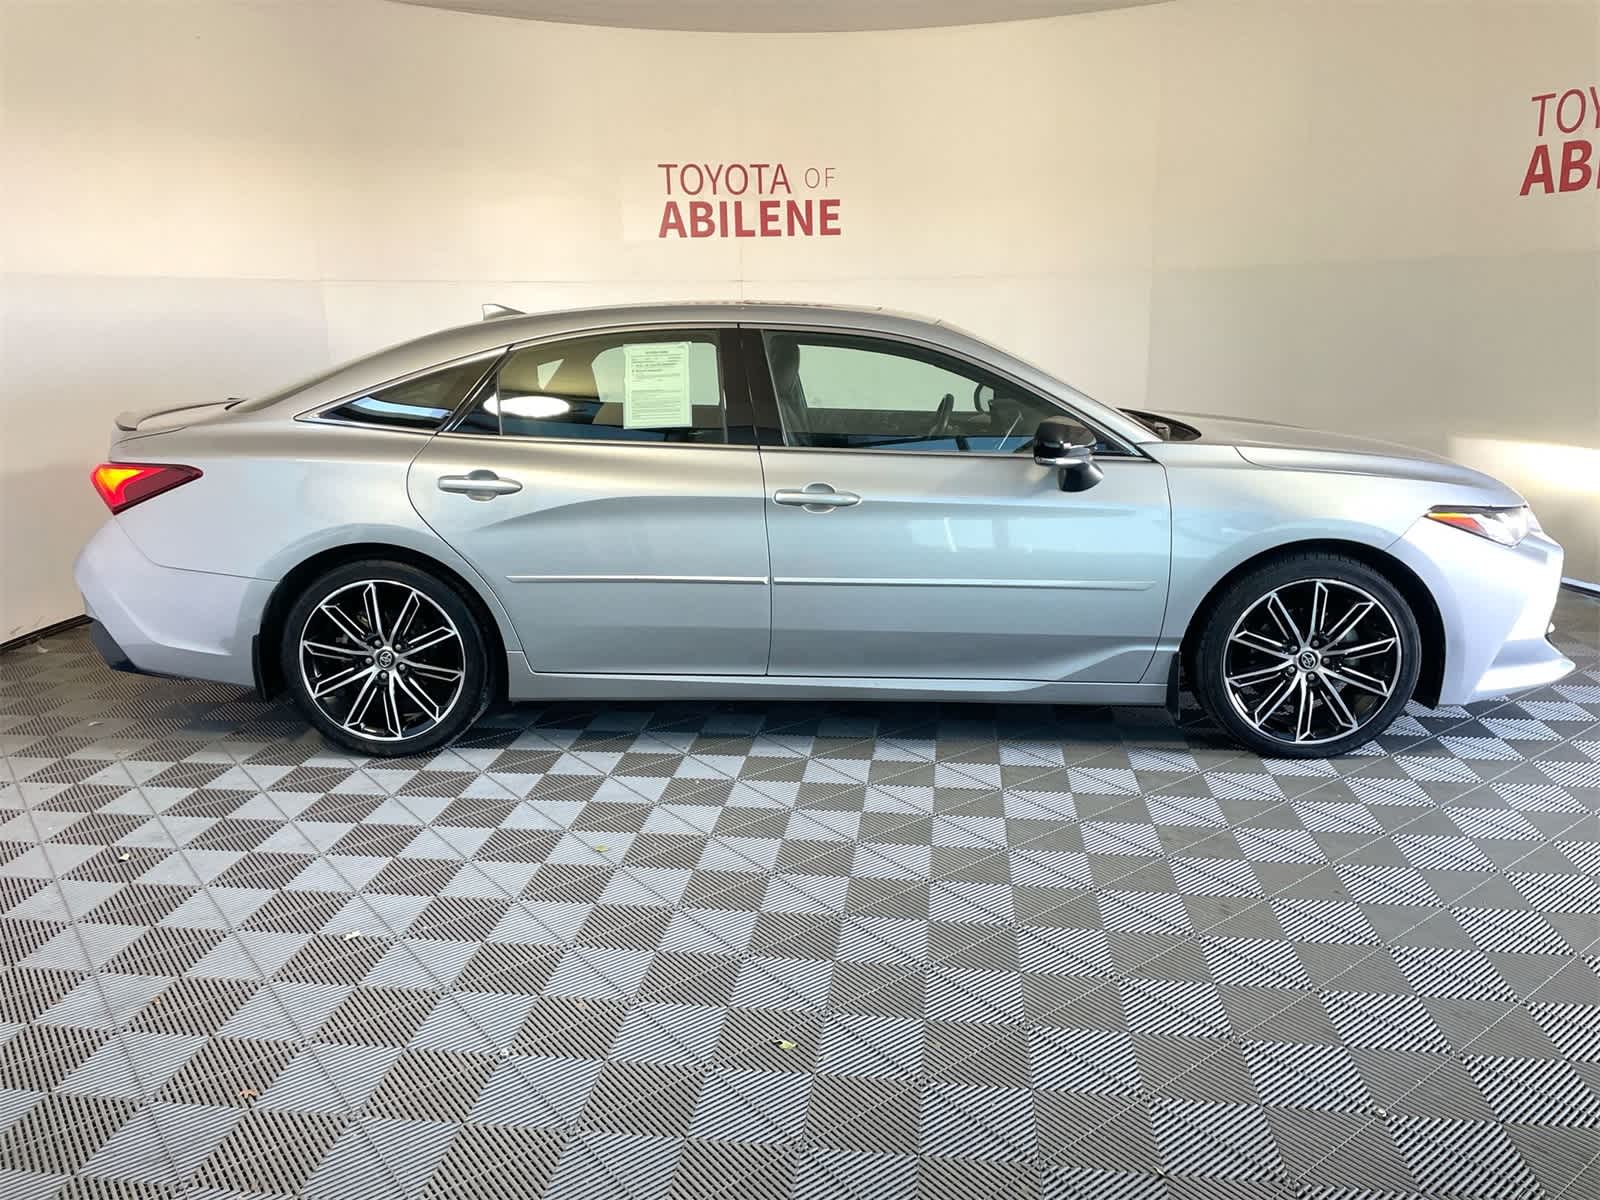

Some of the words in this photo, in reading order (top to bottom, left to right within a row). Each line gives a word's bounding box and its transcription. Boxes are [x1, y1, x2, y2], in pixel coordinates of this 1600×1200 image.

[657, 163, 792, 195] TOYOTA
[804, 167, 836, 189] OF
[658, 199, 841, 238] ABILENE
